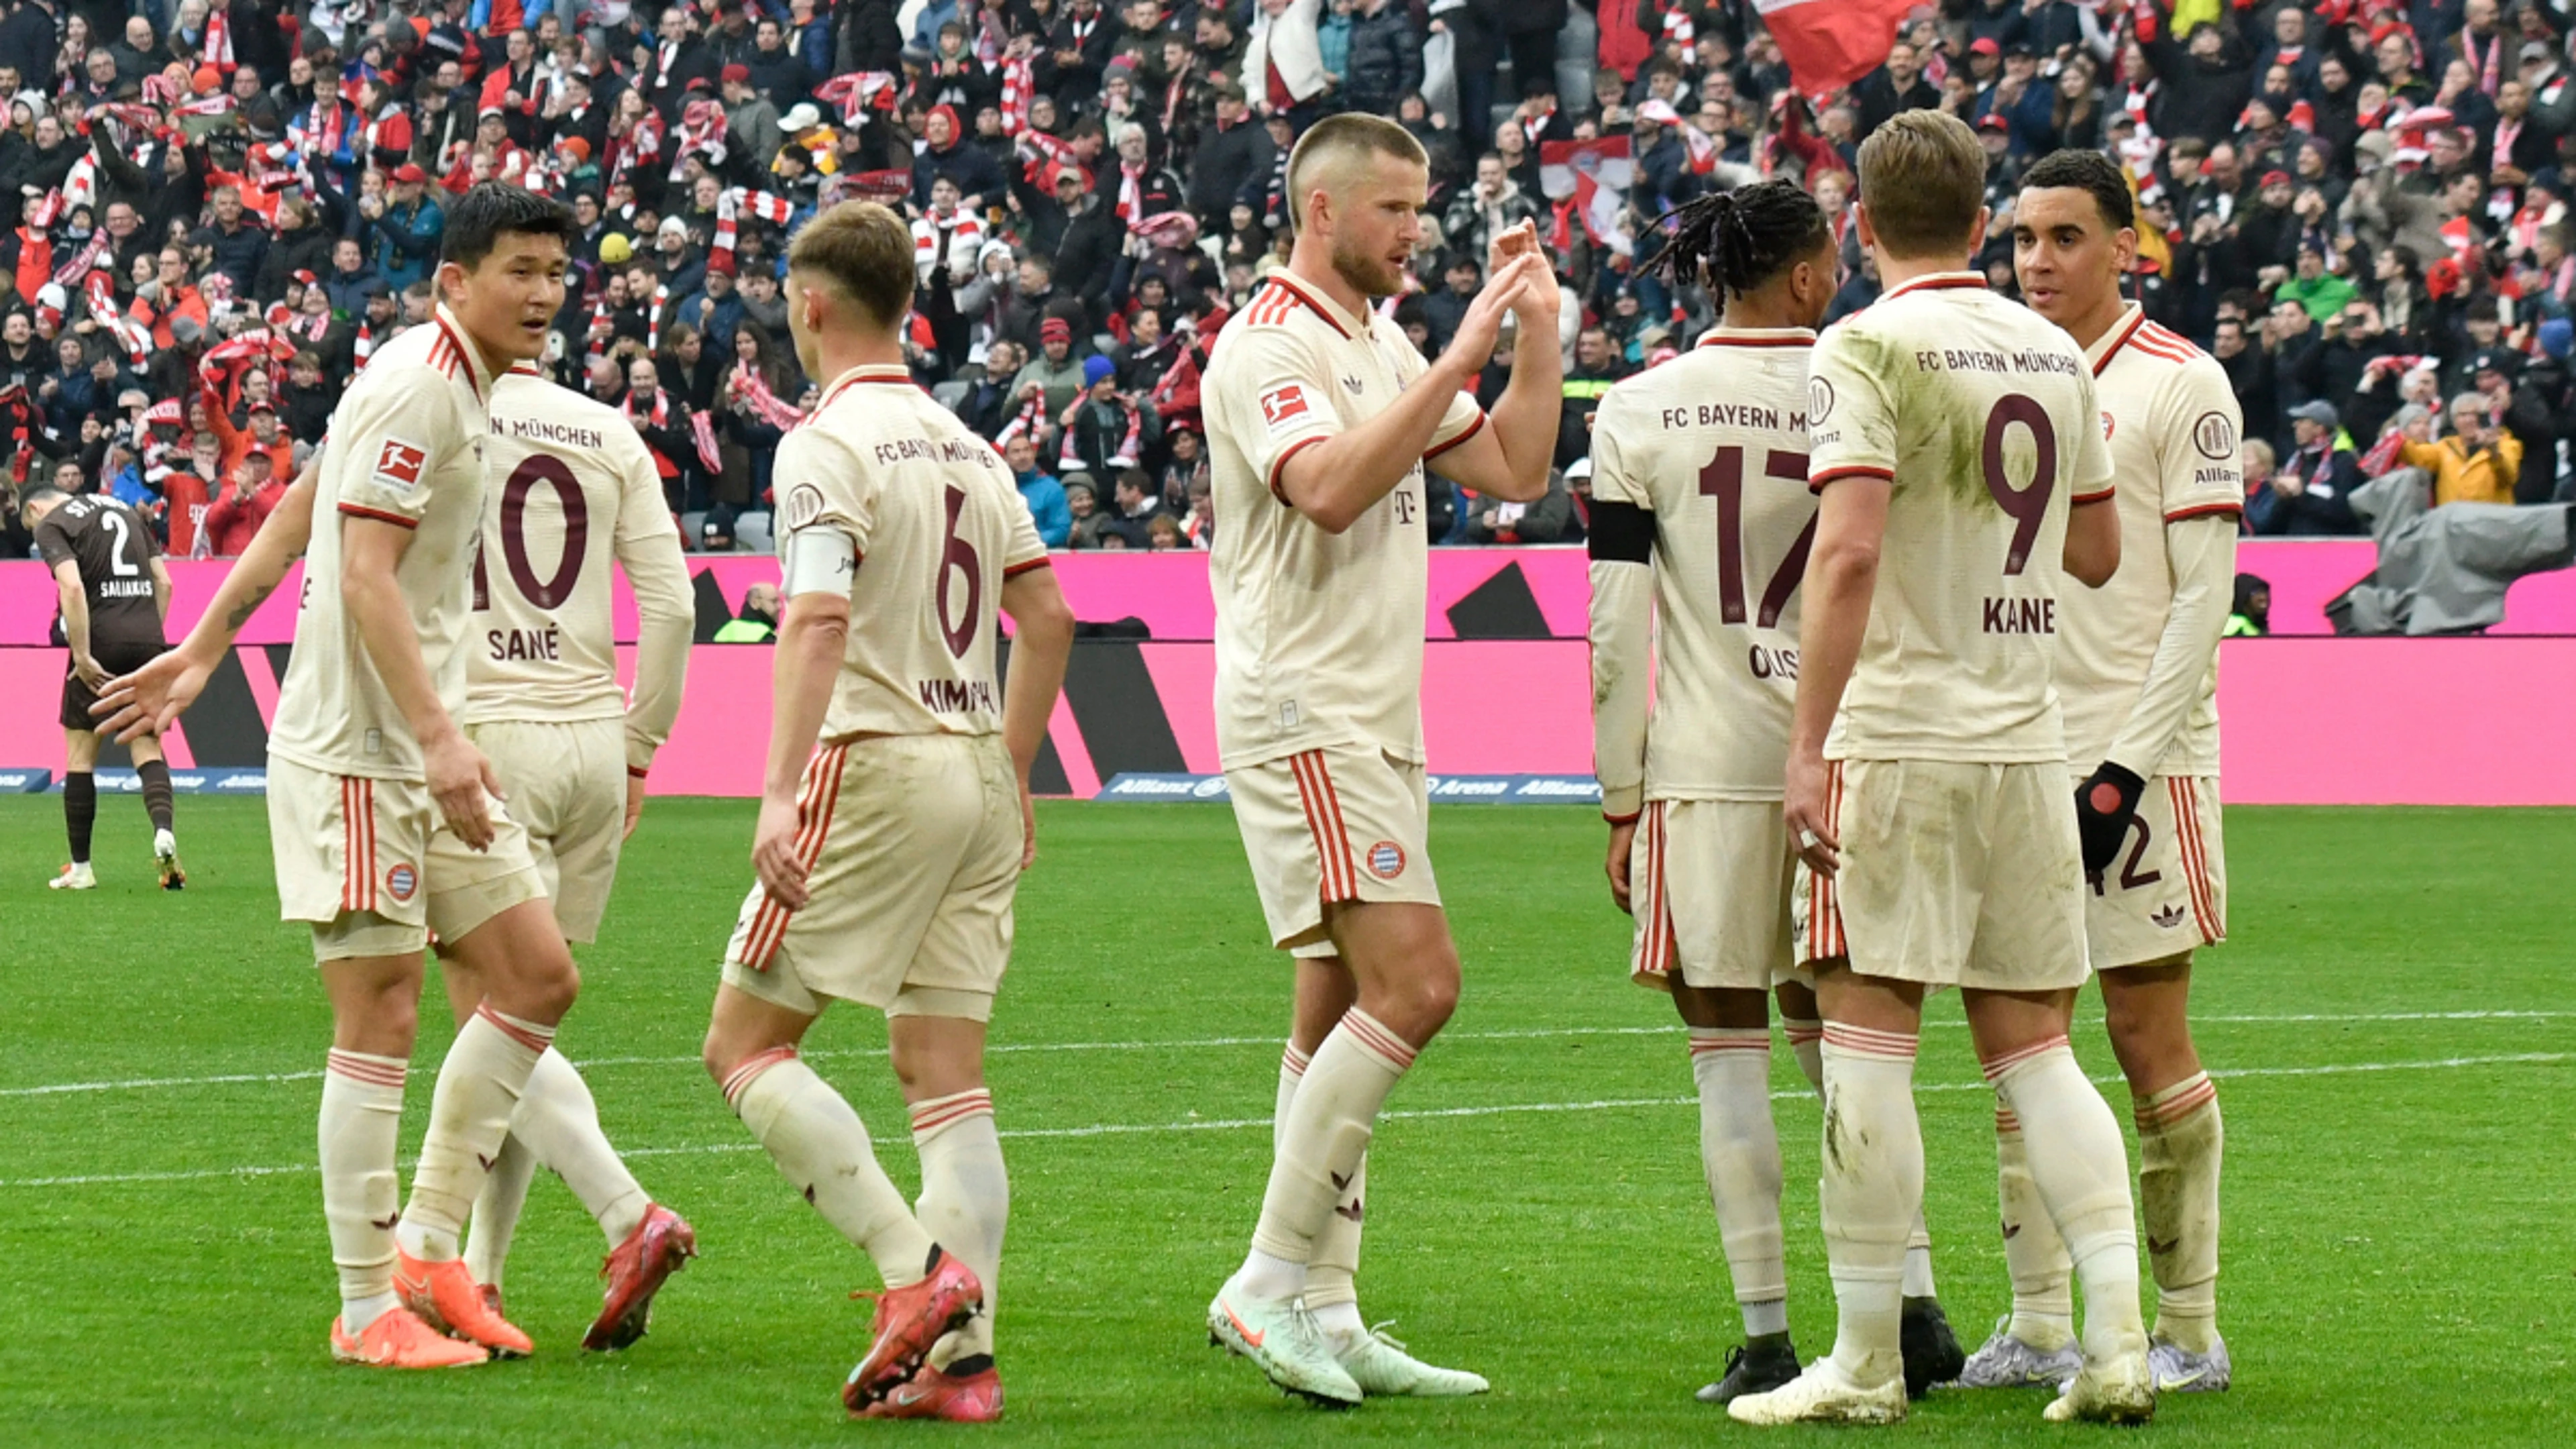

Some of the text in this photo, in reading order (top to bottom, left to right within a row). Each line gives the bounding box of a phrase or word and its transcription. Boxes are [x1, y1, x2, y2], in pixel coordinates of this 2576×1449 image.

[1916, 351, 1940, 372] FC
[1945, 350, 2008, 372] BAYERN
[513, 418, 602, 448] MÜNCHEN
[1663, 407, 1688, 429] FC
[1698, 404, 1778, 429] BAYERN
[875, 443, 899, 466] FC
[1983, 392, 2057, 576] 9
[2195, 467, 2239, 484] Allian
[102, 511, 139, 576] 2
[1699, 445, 1819, 629] 17
[936, 482, 979, 660] 6
[1982, 596, 2055, 634] KANE
[487, 621, 559, 661] SANÉ
[1749, 643, 1800, 680] OLIS
[918, 680, 995, 714] KIMH
[1111, 779, 1509, 795] Allianz Arena
[2086, 813, 2161, 897] 2
